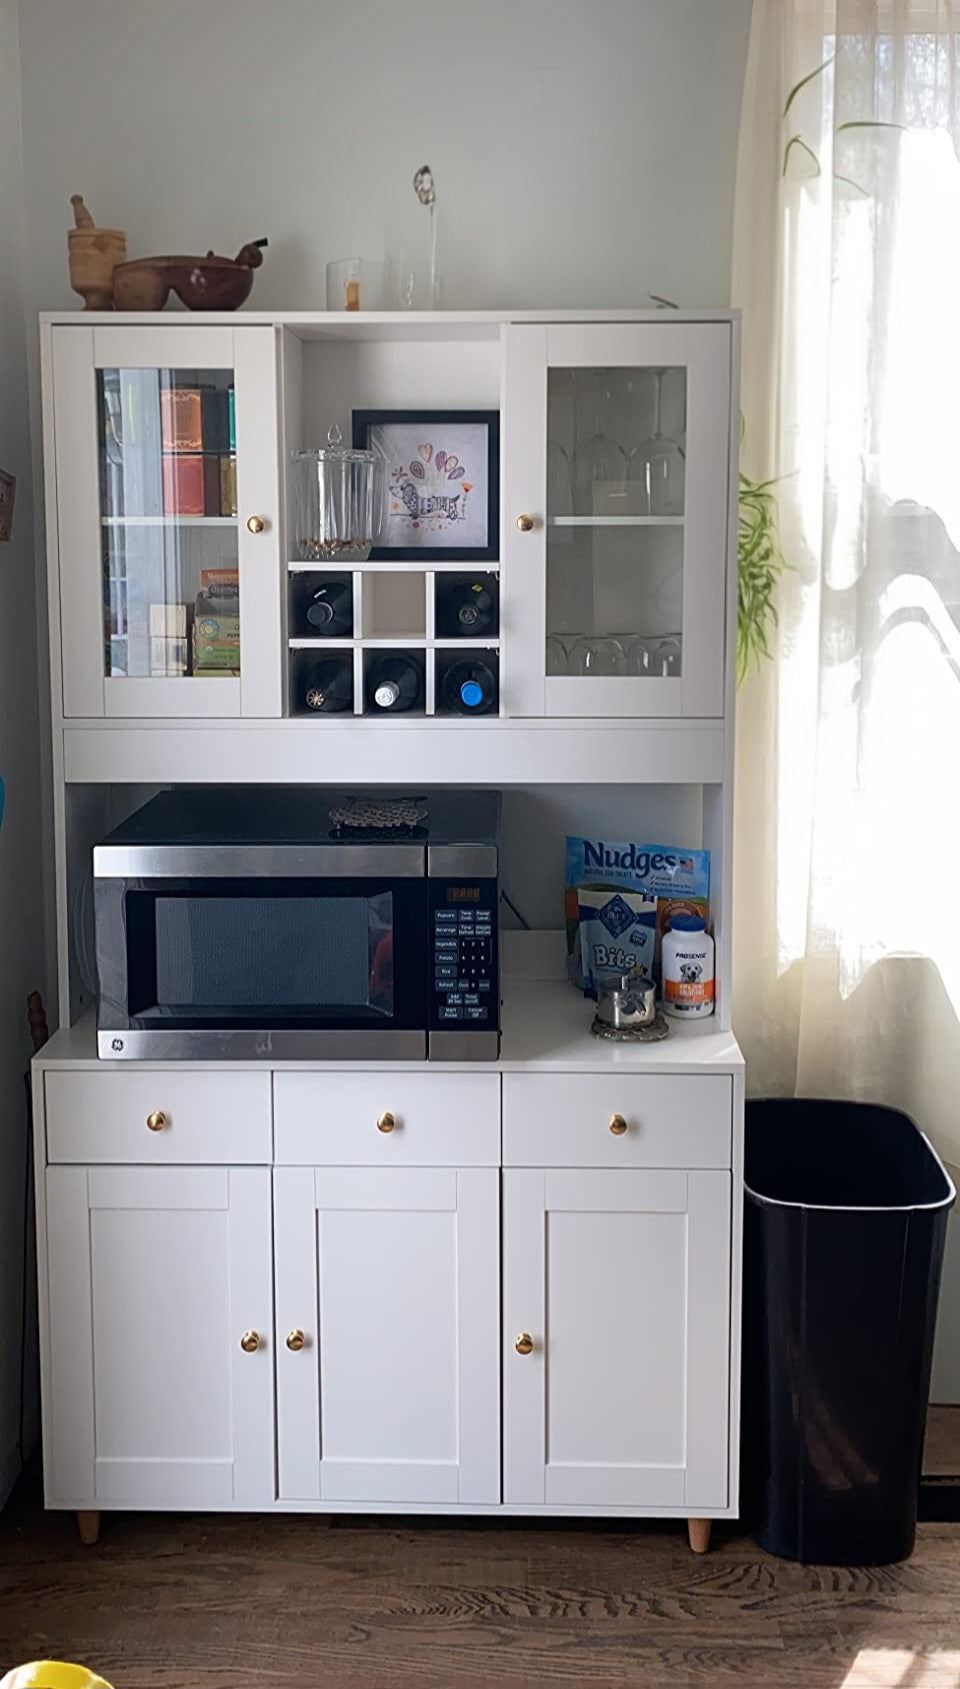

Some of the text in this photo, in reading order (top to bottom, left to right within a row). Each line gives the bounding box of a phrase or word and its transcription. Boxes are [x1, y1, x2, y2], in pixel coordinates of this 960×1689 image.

[583, 840, 676, 878] Nudges
[615, 870, 632, 878] TREATS
[593, 943, 637, 968] Bits
[675, 952, 707, 960] PROSENSE
